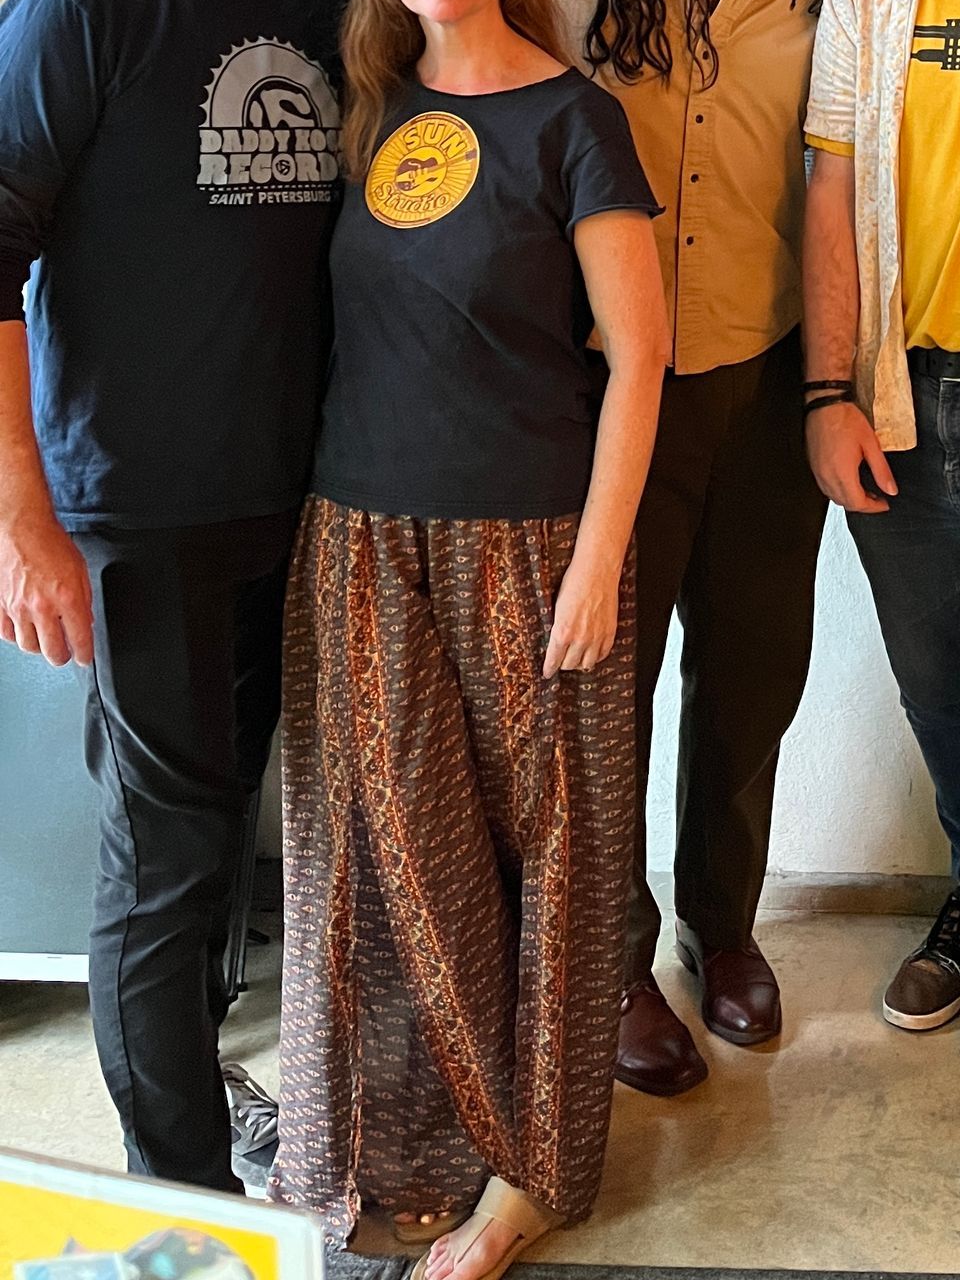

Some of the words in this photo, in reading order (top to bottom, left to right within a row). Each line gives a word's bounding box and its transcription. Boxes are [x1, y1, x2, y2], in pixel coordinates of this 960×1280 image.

[199, 128, 291, 153] DADDY
[402, 122, 468, 160] SUN
[208, 193, 254, 205] SAINT
[258, 190, 332, 204] PETERSBURG
[373, 181, 451, 213] Studio
